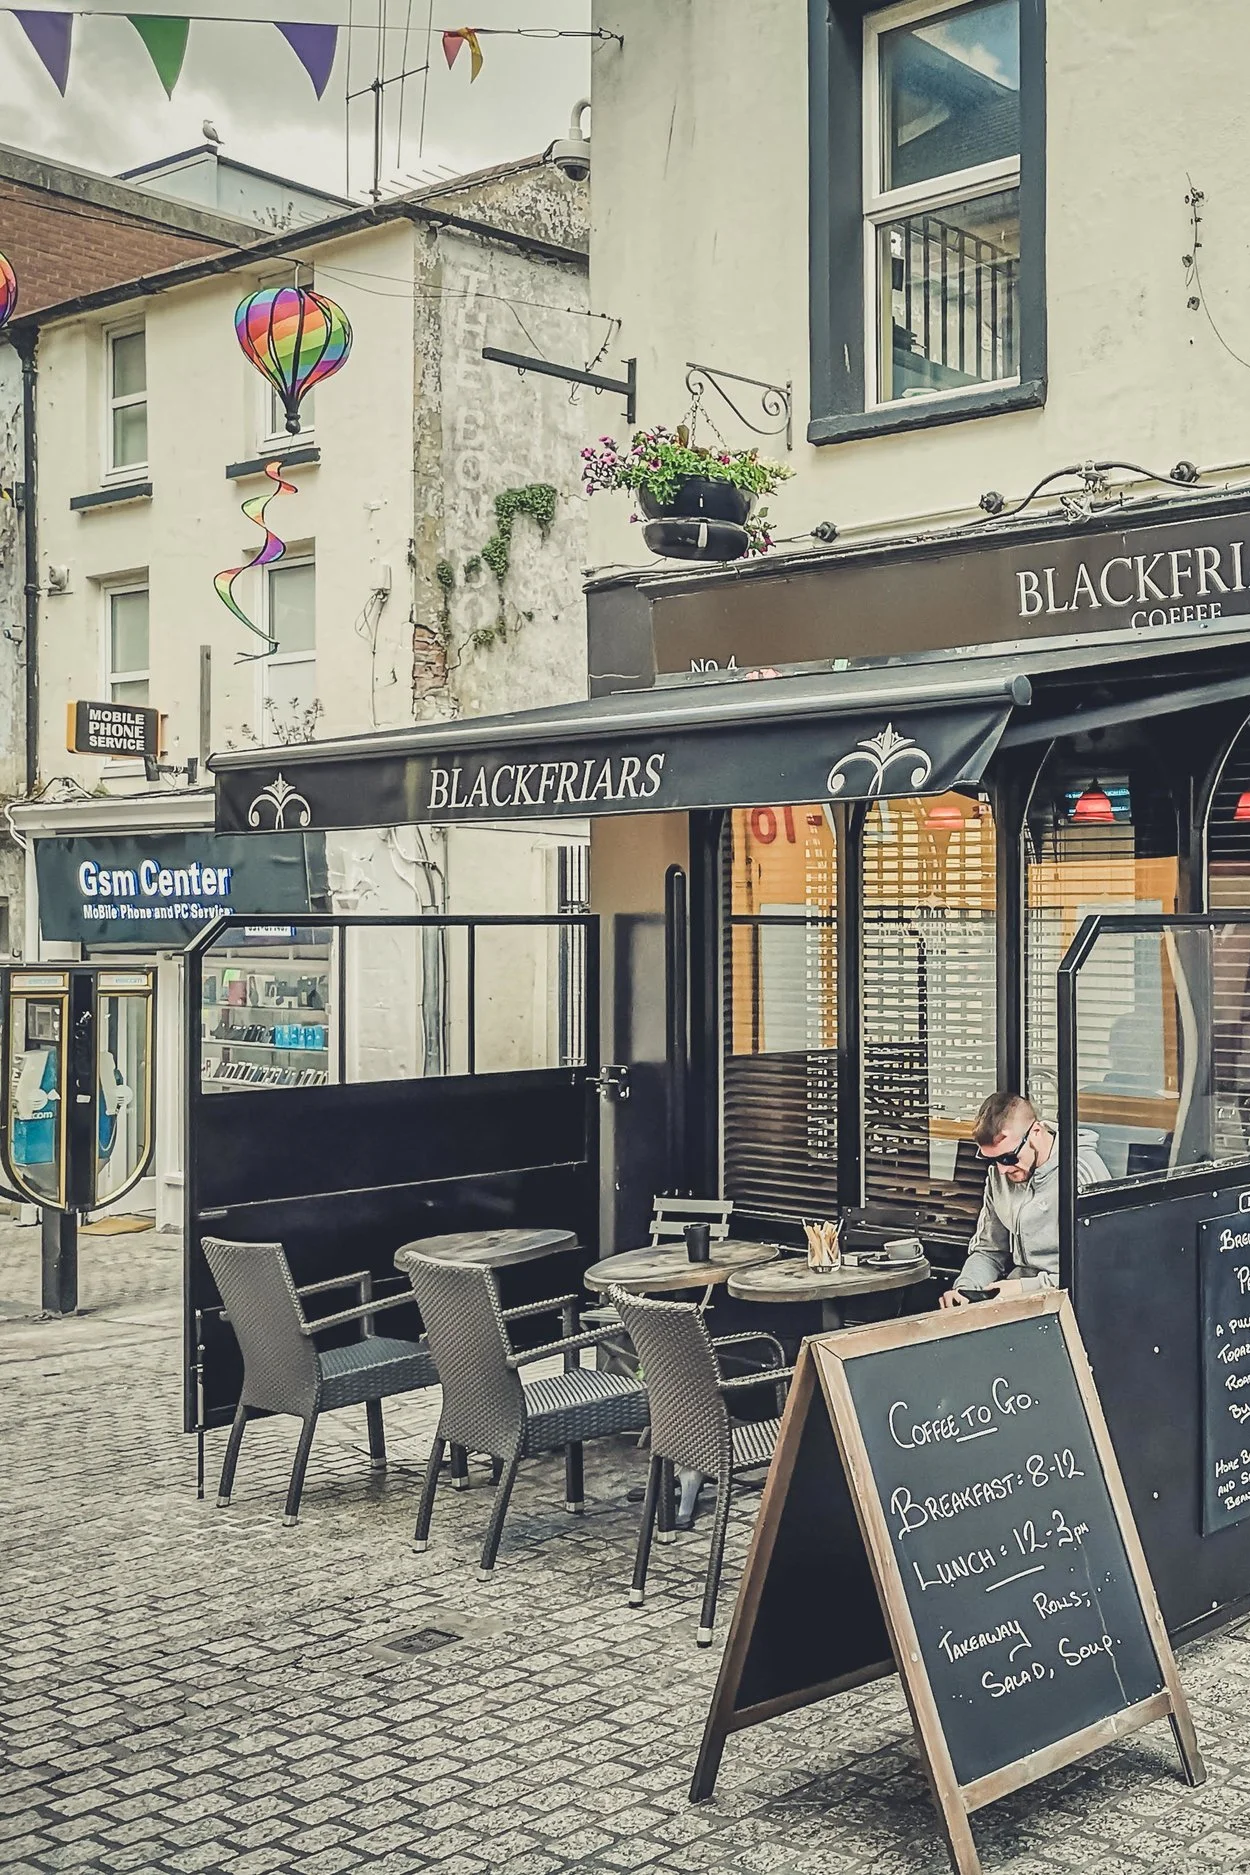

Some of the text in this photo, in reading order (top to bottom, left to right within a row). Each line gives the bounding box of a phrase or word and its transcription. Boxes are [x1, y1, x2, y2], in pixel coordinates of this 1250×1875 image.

[89, 708, 145, 725] MOBILE
[88, 721, 145, 739] PHONE
[89, 735, 145, 751] SERVICE
[427, 753, 665, 809] BLACKFRIARS
[79, 859, 232, 897] Gsm Center
[120, 904, 152, 919] Phone
[154, 906, 173, 919] and
[174, 903, 188, 919] PC
[889, 1401, 960, 1449] COFFEE
[961, 1405, 992, 1428] TO
[1026, 1449, 1085, 1487] 8-12
[1215, 1458, 1240, 1478] HOME
[1217, 1480, 1236, 1497] AND
[938, 1620, 1032, 1663] TAKEAWAY
